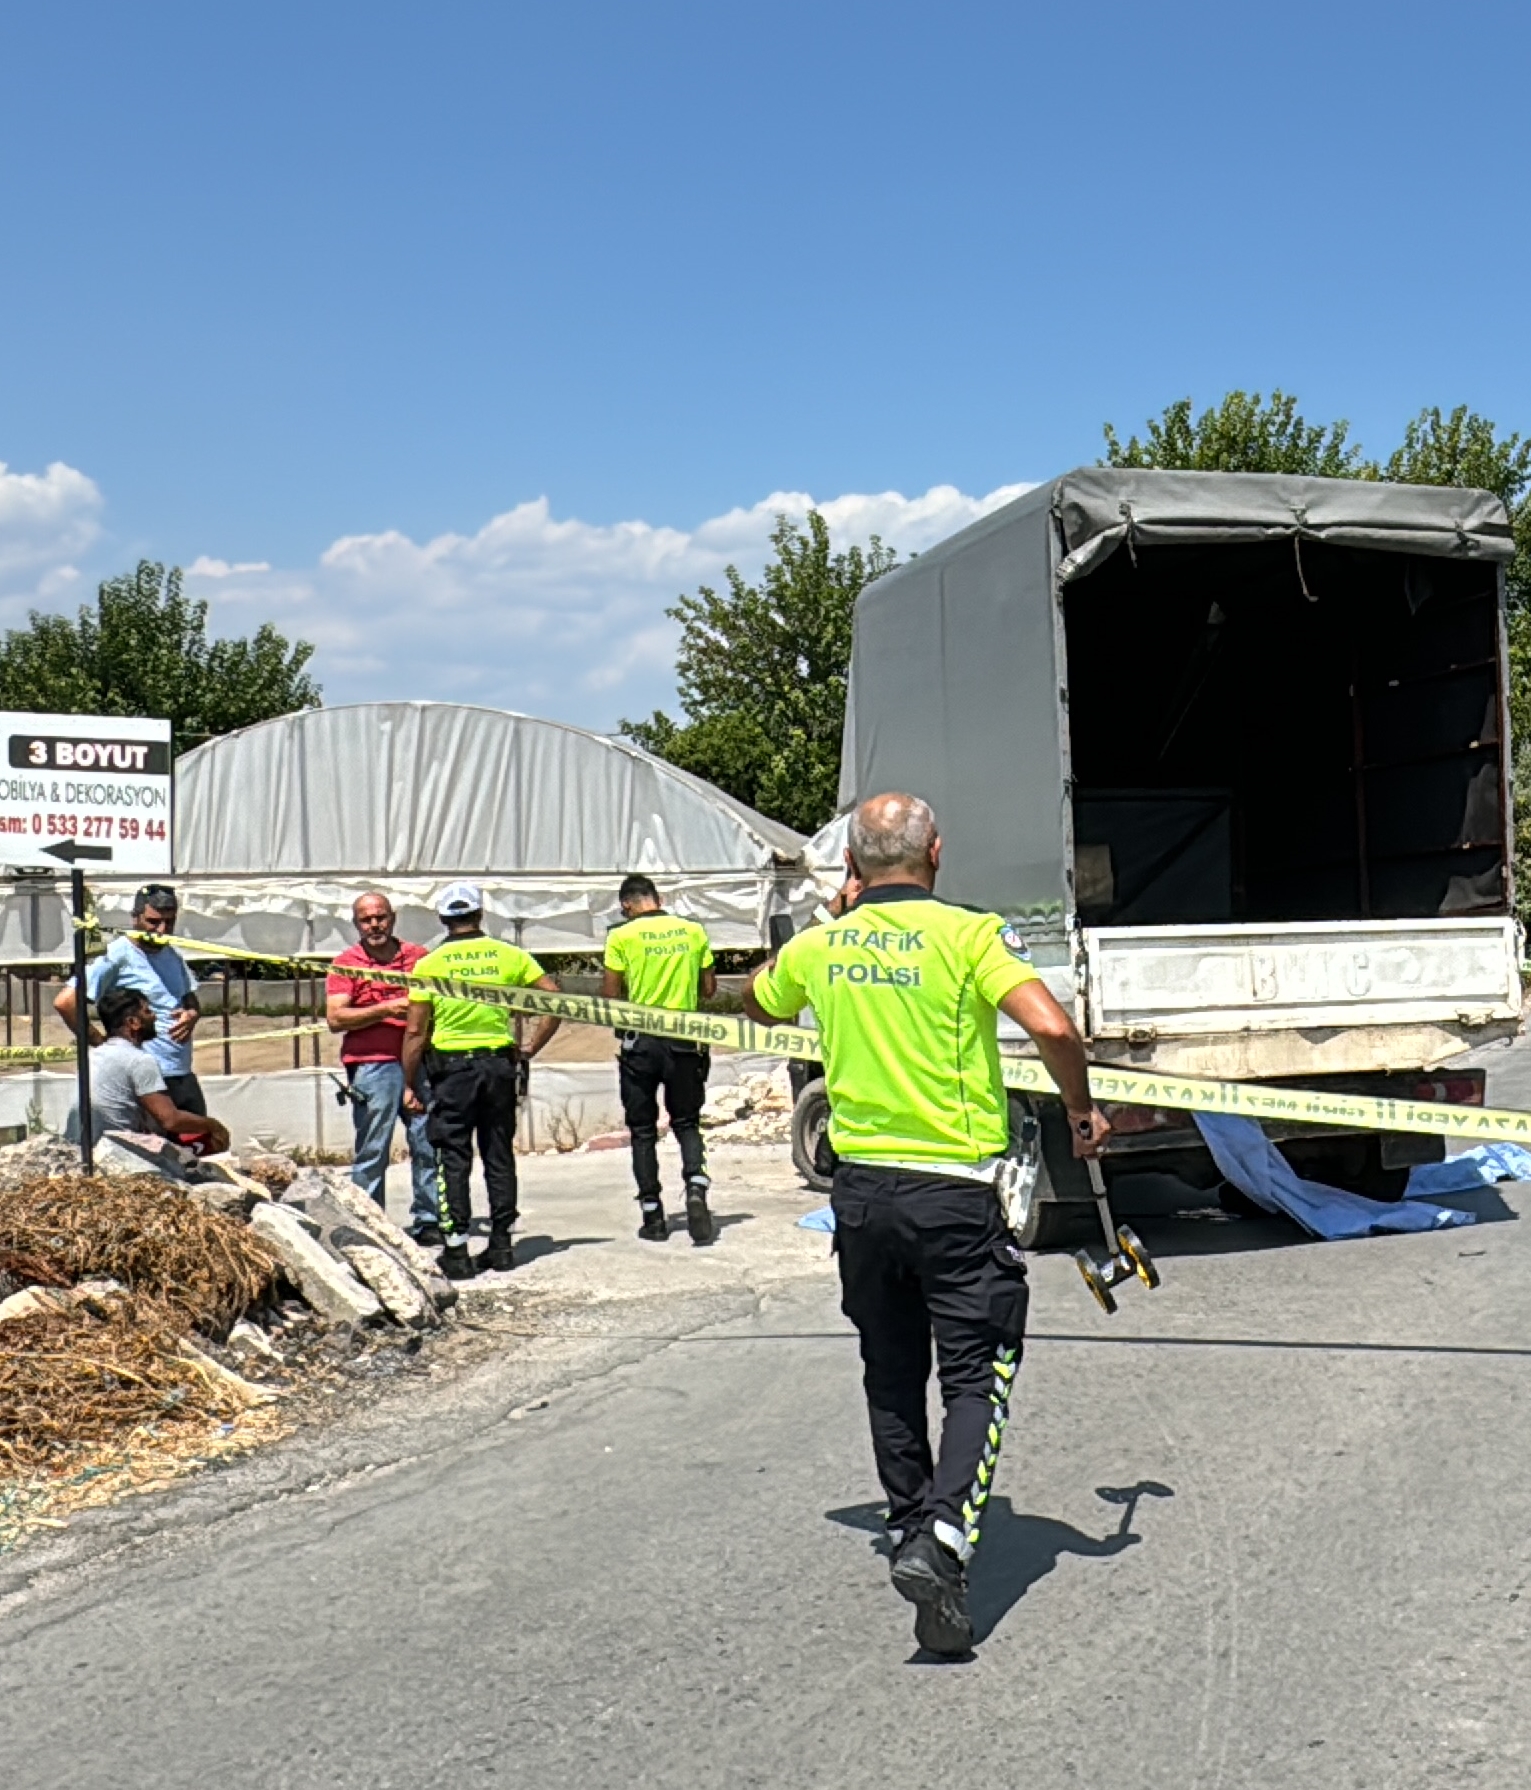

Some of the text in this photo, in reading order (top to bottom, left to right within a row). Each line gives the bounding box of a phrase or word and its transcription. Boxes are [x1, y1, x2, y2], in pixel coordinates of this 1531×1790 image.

[28, 740, 148, 769] 3 BOYUT
[51, 781, 61, 802] &
[65, 782, 166, 808] DEKORASYON
[32, 813, 42, 836] 0
[47, 813, 78, 837] 533
[83, 816, 114, 839] 277
[119, 817, 139, 840] 59
[145, 819, 166, 841] 44
